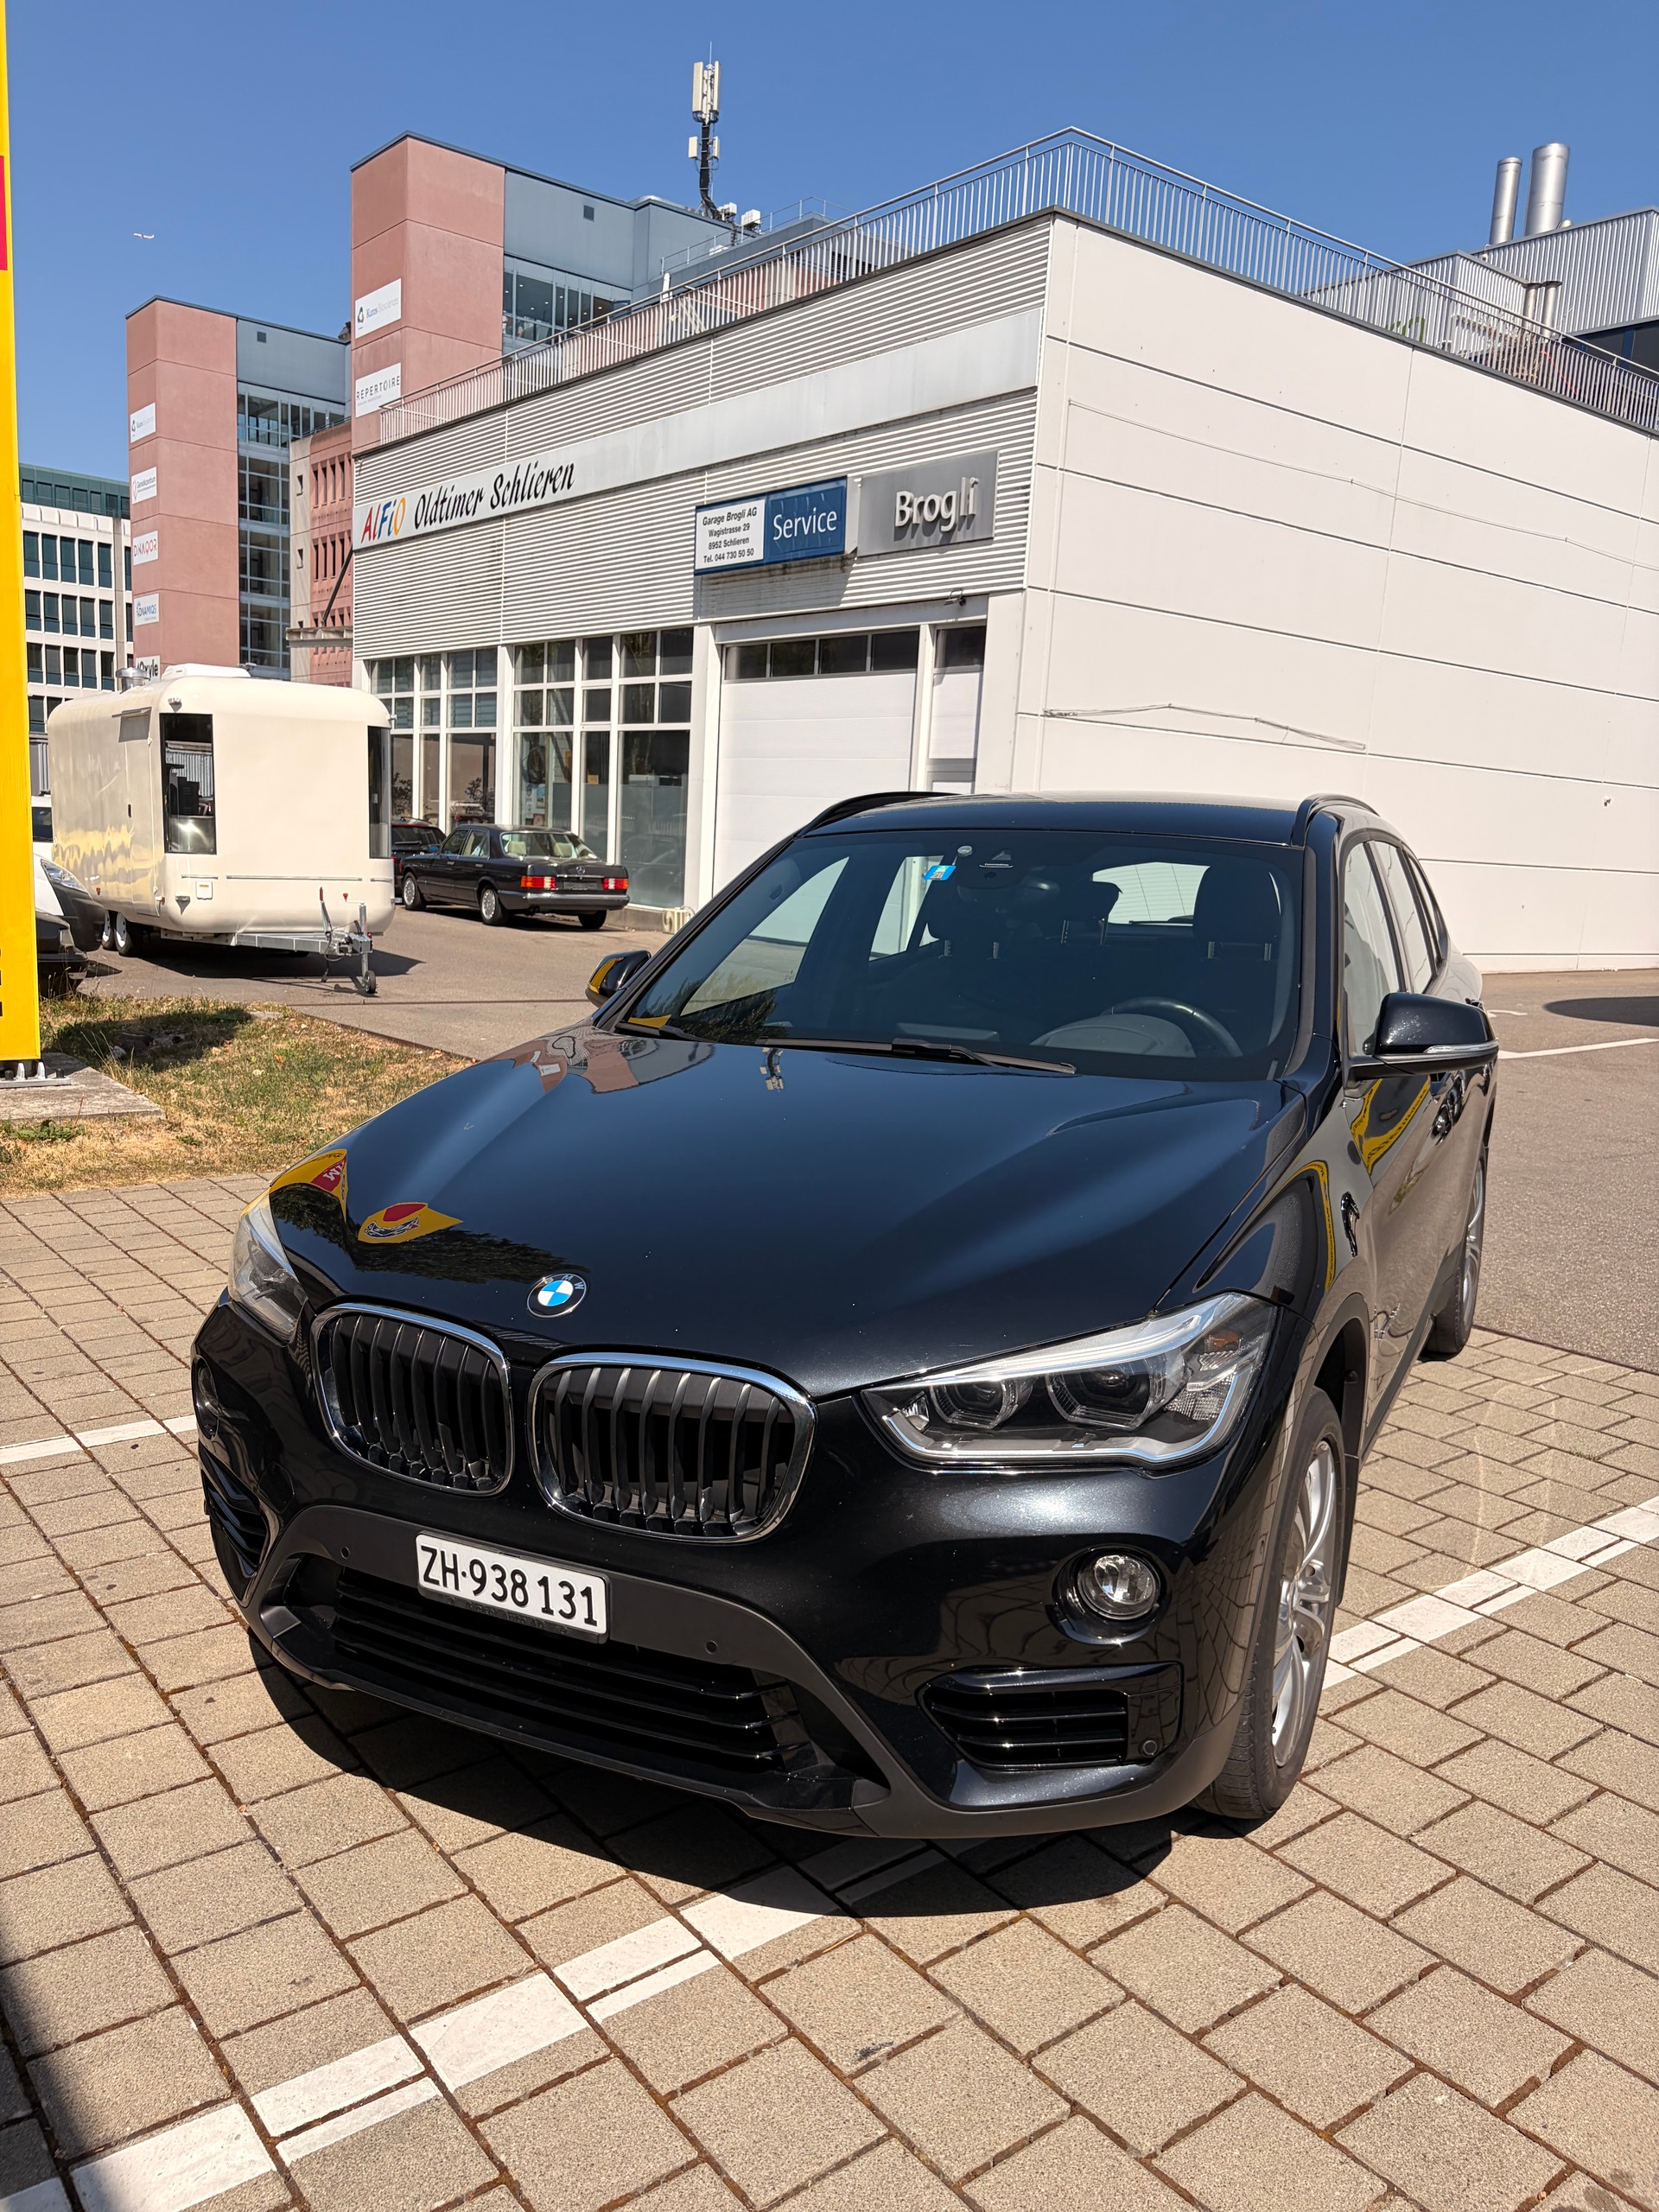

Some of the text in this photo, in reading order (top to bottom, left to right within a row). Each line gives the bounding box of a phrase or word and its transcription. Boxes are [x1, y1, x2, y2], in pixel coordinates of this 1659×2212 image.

[356, 375, 400, 400] REPERTOIRE
[414, 485, 486, 530] Oldtimer
[490, 461, 575, 509] Schlieren
[894, 477, 980, 532] Brogli
[702, 507, 757, 525] Garage Brogli AG
[773, 506, 837, 541] Service
[709, 523, 750, 537] Wagistrasse 29
[709, 537, 749, 550] 8952 Schlieren
[703, 548, 754, 563] Tel. 044 730 50 50
